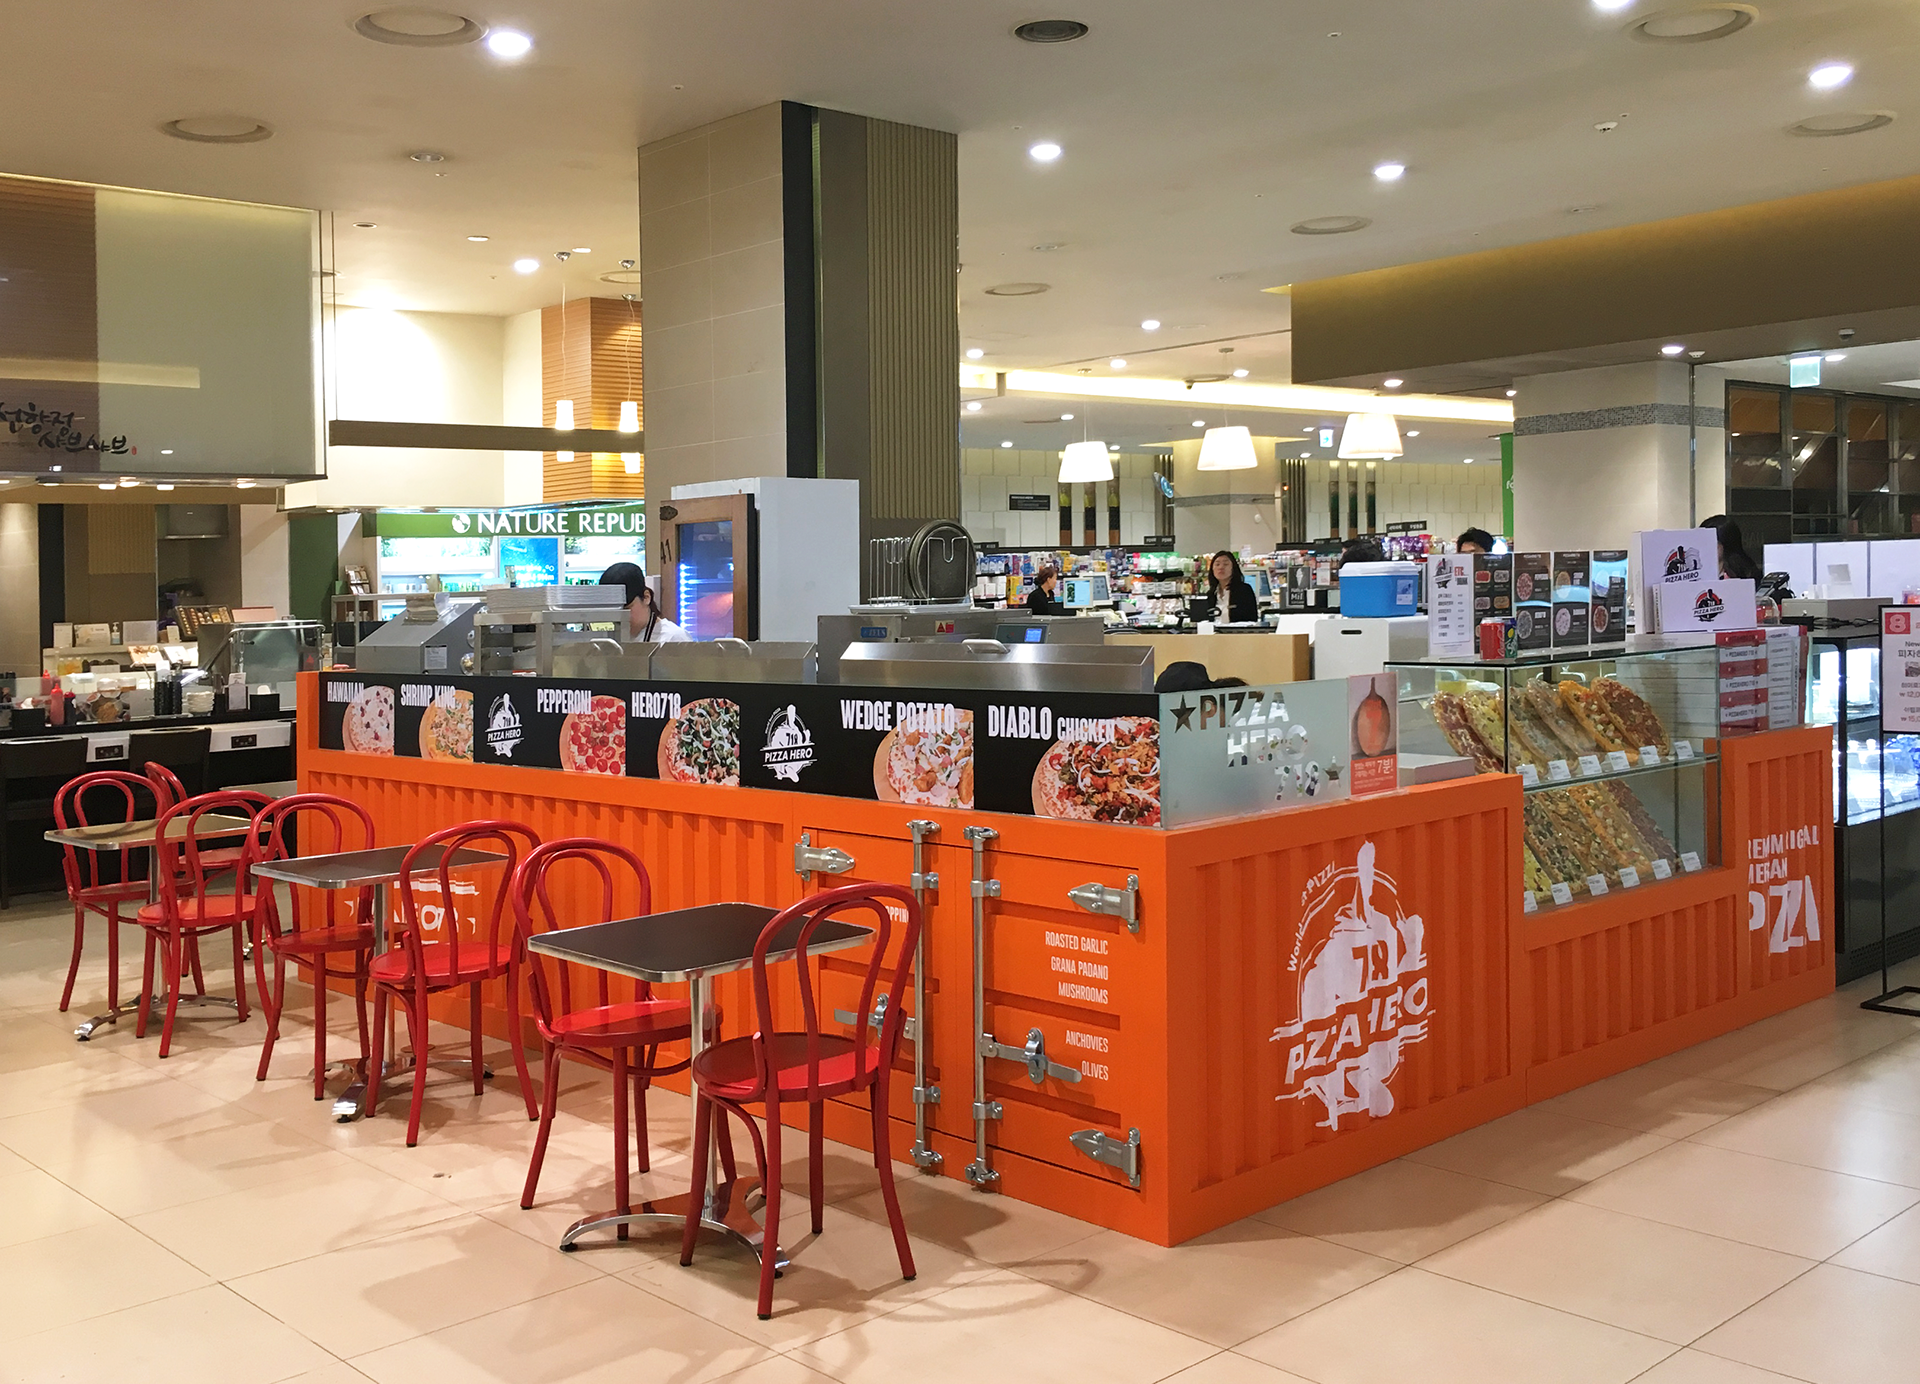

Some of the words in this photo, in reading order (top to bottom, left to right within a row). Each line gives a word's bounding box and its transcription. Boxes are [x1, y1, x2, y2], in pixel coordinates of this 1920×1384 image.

[477, 513, 569, 534] NATURE
[579, 512, 645, 534] REPUB
[1665, 575, 1682, 583] PIZZA
[1682, 571, 1699, 581] HERO
[1710, 605, 1725, 613] HERO
[327, 681, 365, 704] HAWAIIAN
[400, 683, 433, 708] SHRIMP
[434, 686, 456, 709] KING
[537, 688, 591, 715] PEPPERONI
[631, 691, 681, 721] HERO718
[840, 699, 892, 731] WEDGE
[896, 702, 955, 736] POTATO
[1200, 691, 1290, 730] PIZZA
[487, 731, 504, 742] PIZZA
[505, 729, 521, 739] HERO
[988, 705, 1052, 741] DIABLO
[1057, 716, 1115, 743] CHICKEN
[764, 750, 788, 763] PIZZA
[790, 747, 813, 760] HERO
[1227, 724, 1308, 768] HERO
[1274, 760, 1320, 801] 718
[1045, 931, 1078, 951] ROASTED
[1080, 937, 1108, 956] GARLIC
[1050, 956, 1076, 975] GRANA
[1078, 960, 1108, 981] PADANO
[1058, 981, 1108, 1005] MUSHROOMS
[1065, 1030, 1108, 1053] ANCHOVIES
[1081, 1061, 1108, 1081] OLIVES
